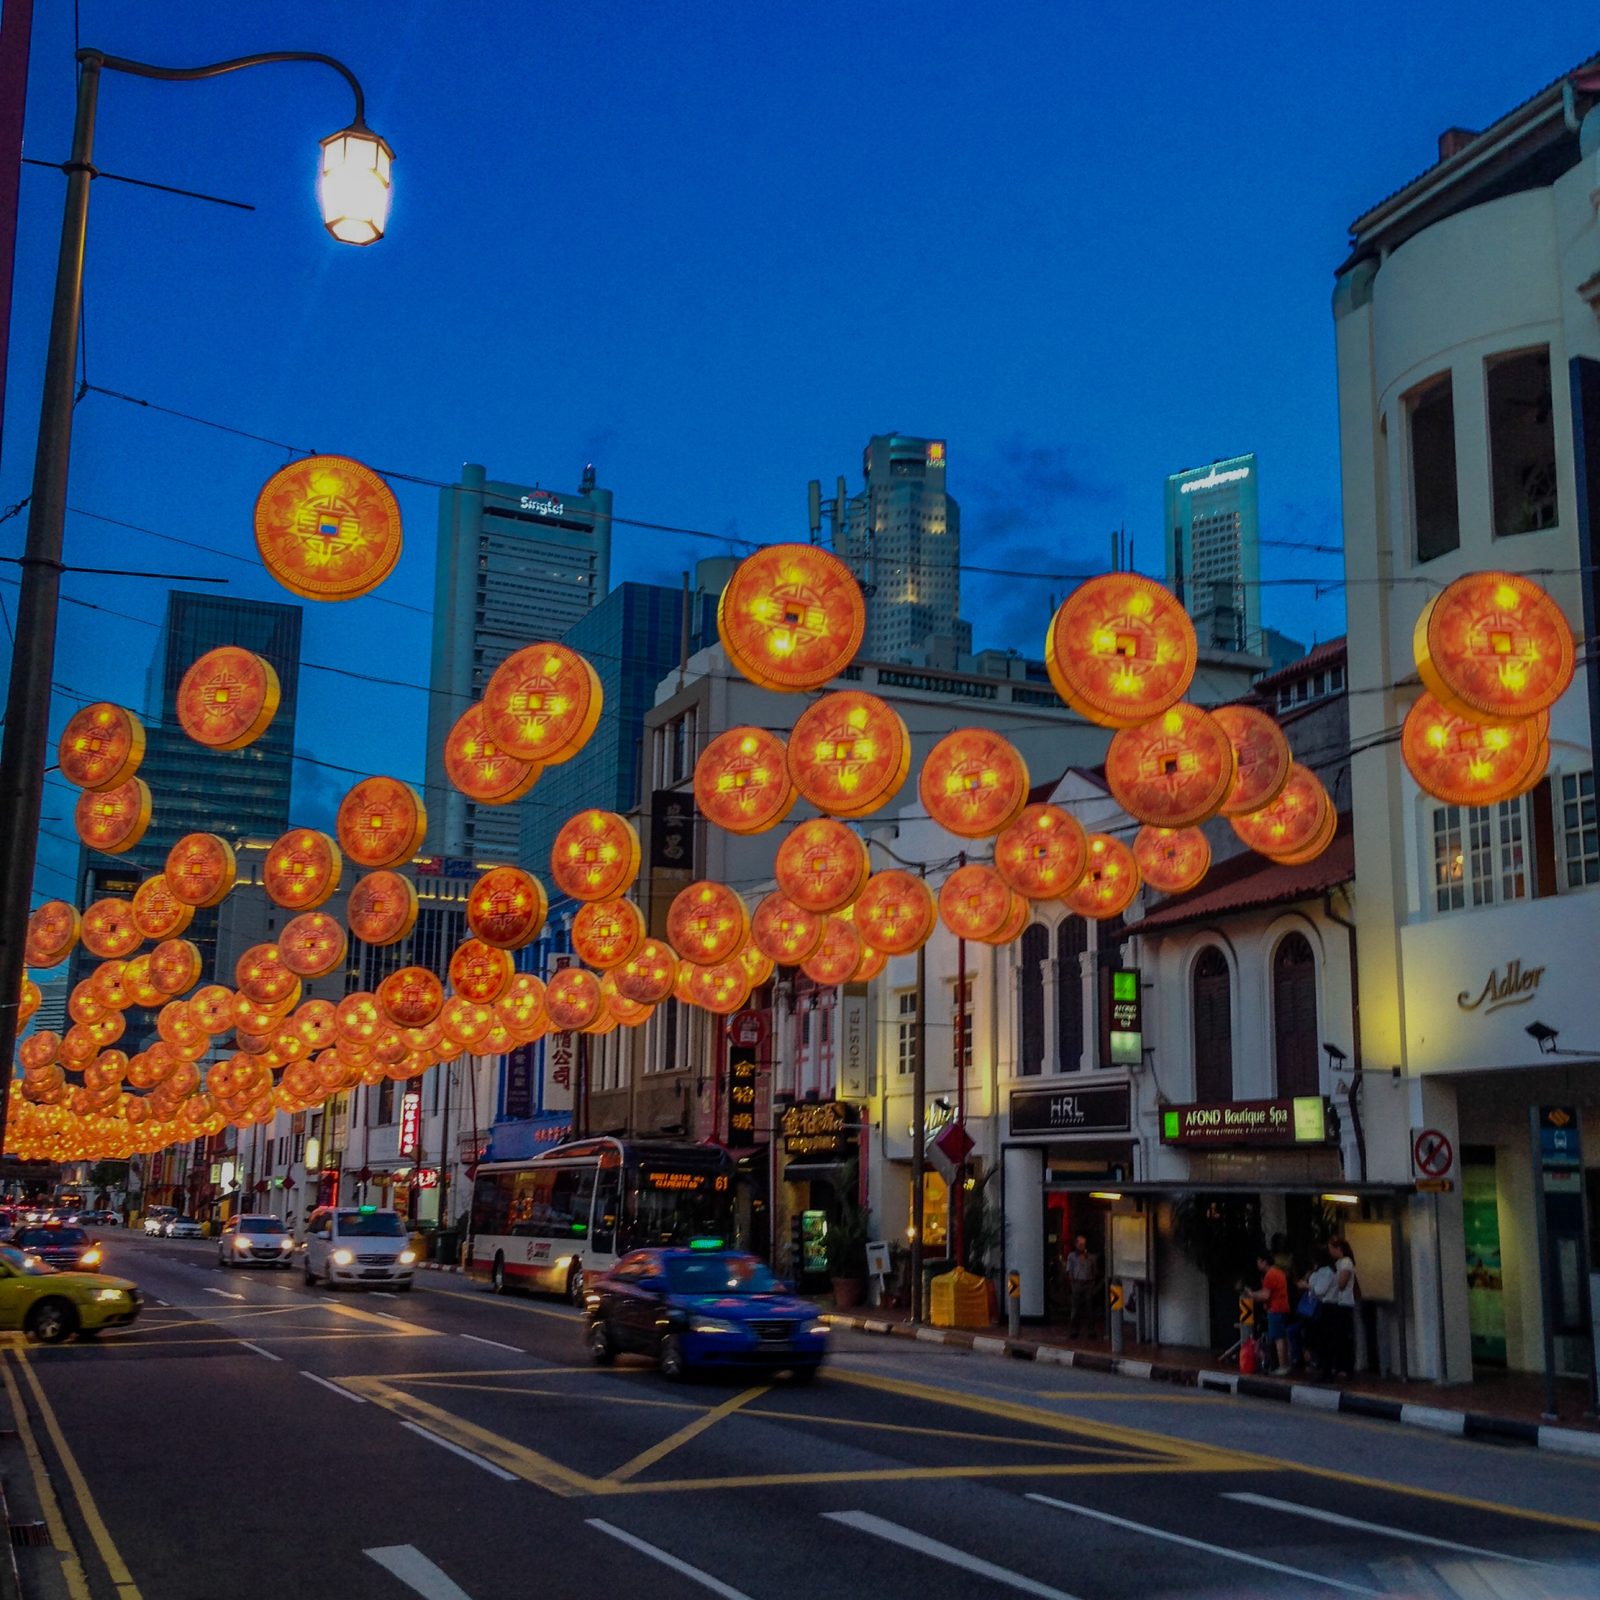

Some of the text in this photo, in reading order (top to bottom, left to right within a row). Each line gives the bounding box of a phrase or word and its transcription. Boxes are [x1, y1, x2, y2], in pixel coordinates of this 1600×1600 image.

[520, 496, 564, 515] Singtel
[1457, 958, 1545, 1011] Adler
[849, 1008, 860, 1069] HOSTEL
[1050, 1096, 1084, 1117] HRL
[1185, 1106, 1288, 1126] AFOND Boutique Spa
[715, 1175, 728, 1191] 61
